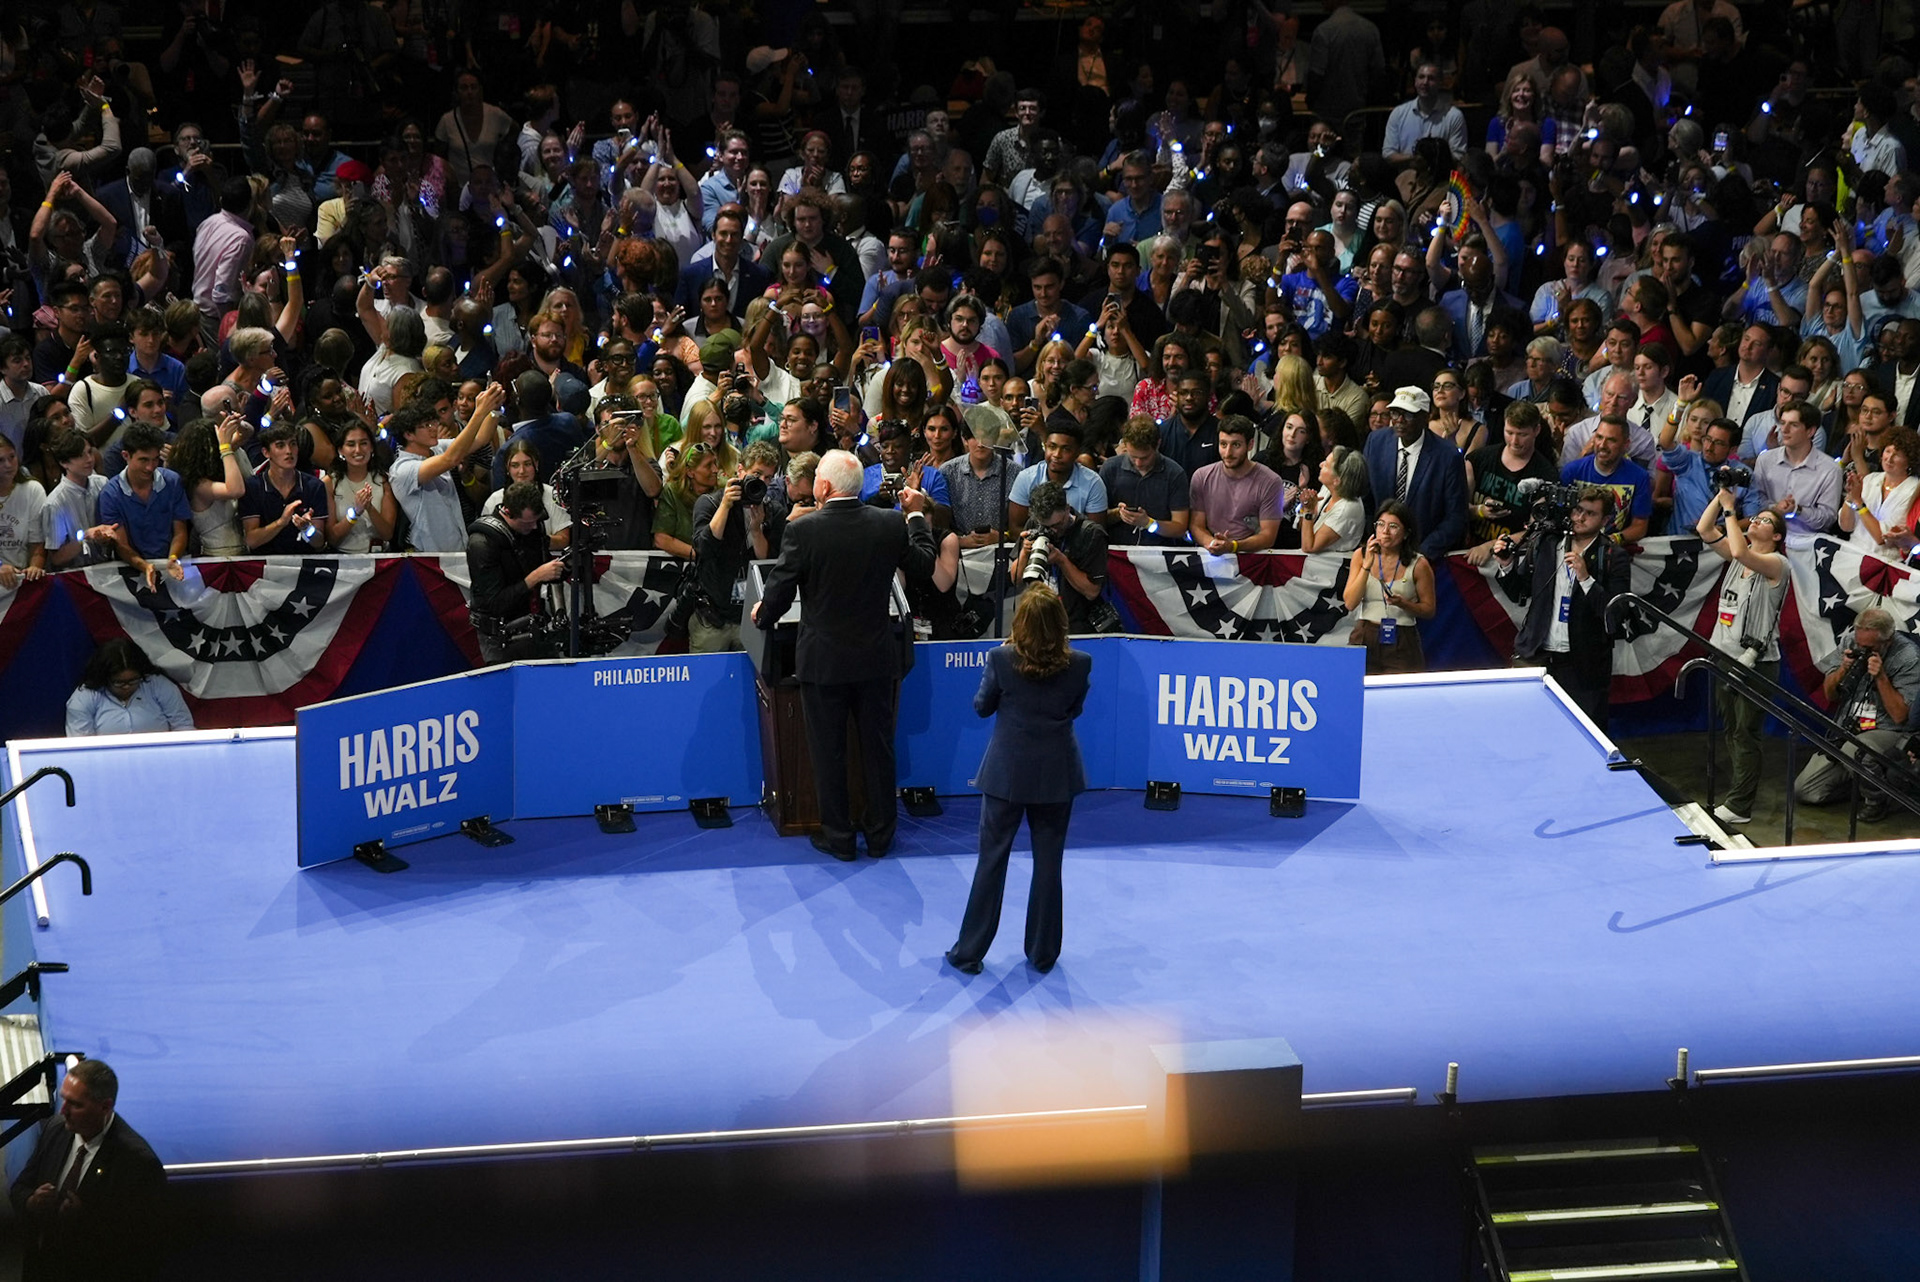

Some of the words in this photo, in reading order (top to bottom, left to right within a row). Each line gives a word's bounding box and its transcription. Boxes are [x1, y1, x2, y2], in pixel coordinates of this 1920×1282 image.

[887, 109, 925, 132] HARR
[594, 665, 690, 687] PHILADELPHIA
[1157, 673, 1318, 732] HARRIS
[339, 709, 480, 791] HARRIS
[1183, 732, 1291, 764] WALZ
[363, 772, 458, 819] WALZ
